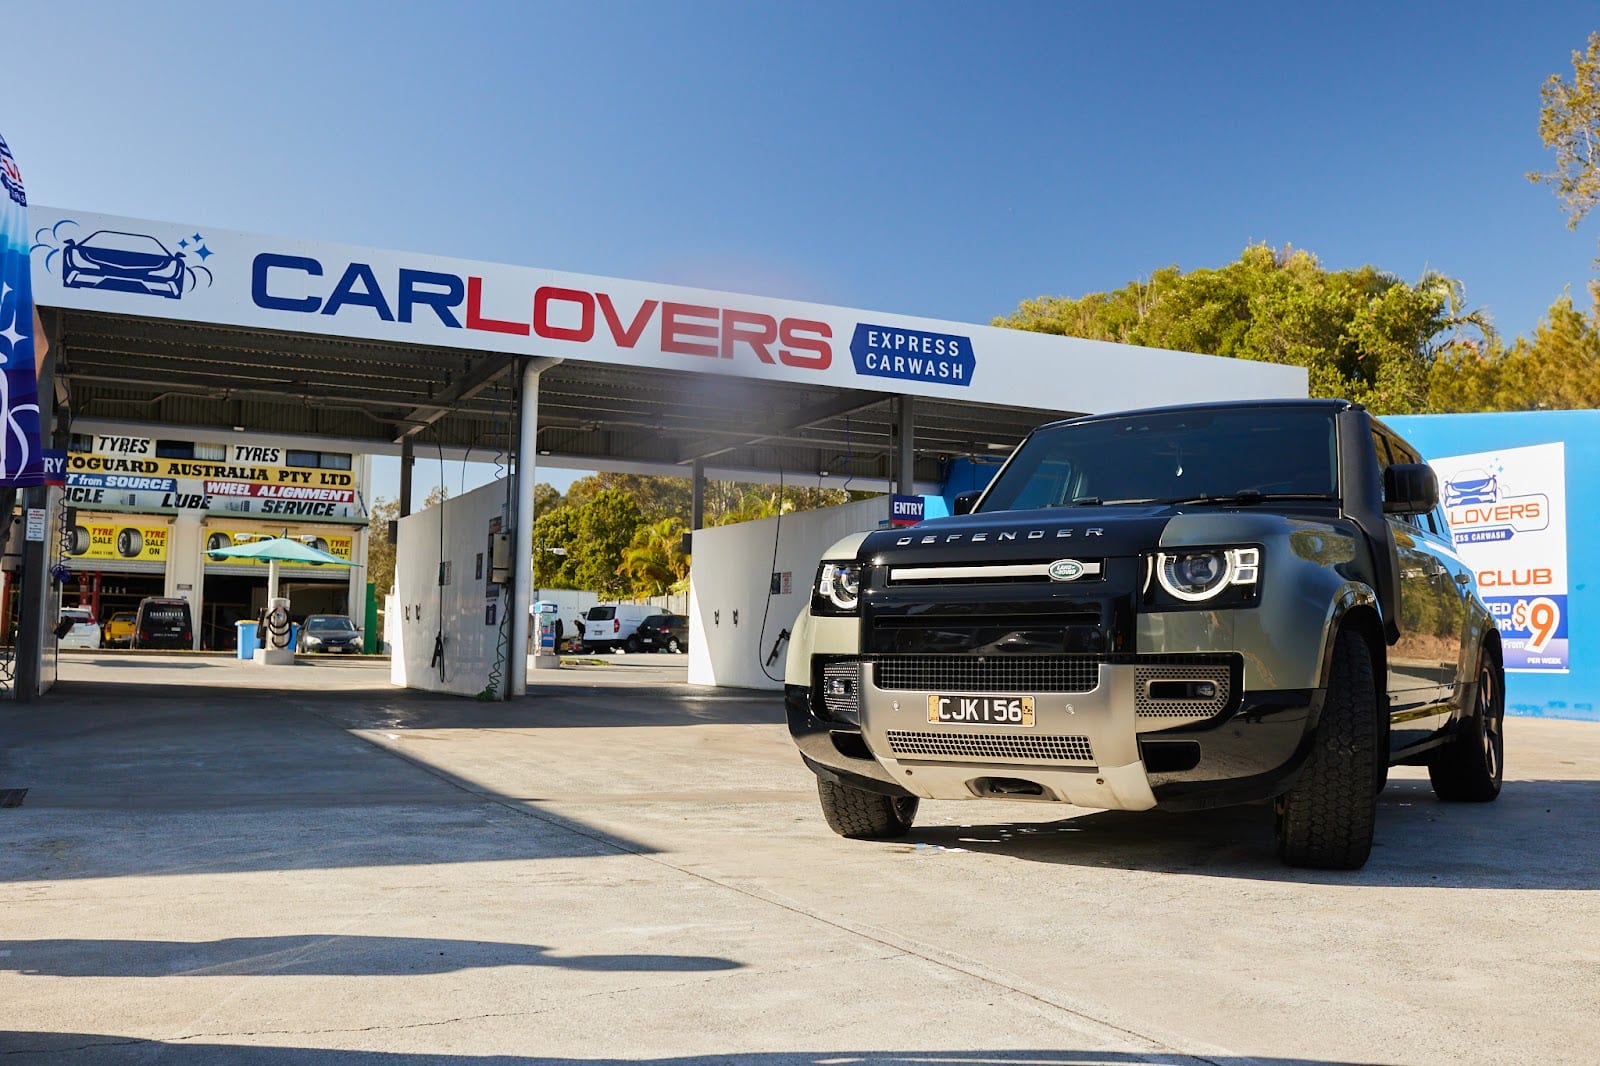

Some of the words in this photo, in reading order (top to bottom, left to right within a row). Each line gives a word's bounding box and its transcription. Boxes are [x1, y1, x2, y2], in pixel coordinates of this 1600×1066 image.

[868, 331, 960, 356] EXPRESS
[865, 353, 963, 380] CARWASH
[99, 437, 150, 454] TYRES
[235, 446, 280, 463] TYRES
[43, 457, 64, 473] RY
[79, 475, 102, 487] from
[105, 476, 172, 490] SOURCE
[168, 463, 269, 481] AUSTRALIA
[278, 470, 312, 483] PTY
[320, 473, 351, 486] LTD
[206, 482, 251, 496] WHEEL
[257, 486, 352, 502] ALIGNMENT
[161, 493, 213, 510] LUBE
[261, 500, 337, 516] SERVICE
[894, 502, 923, 515] ENTRY
[92, 528, 114, 536] TYRE
[144, 530, 166, 538] TYRE
[896, 526, 1104, 546] DEFENDER
[1472, 531, 1506, 541] CARWASH
[330, 539, 349, 547] TYRE
[1478, 568, 1553, 587] CLUB
[1542, 657, 1562, 665] WEEK
